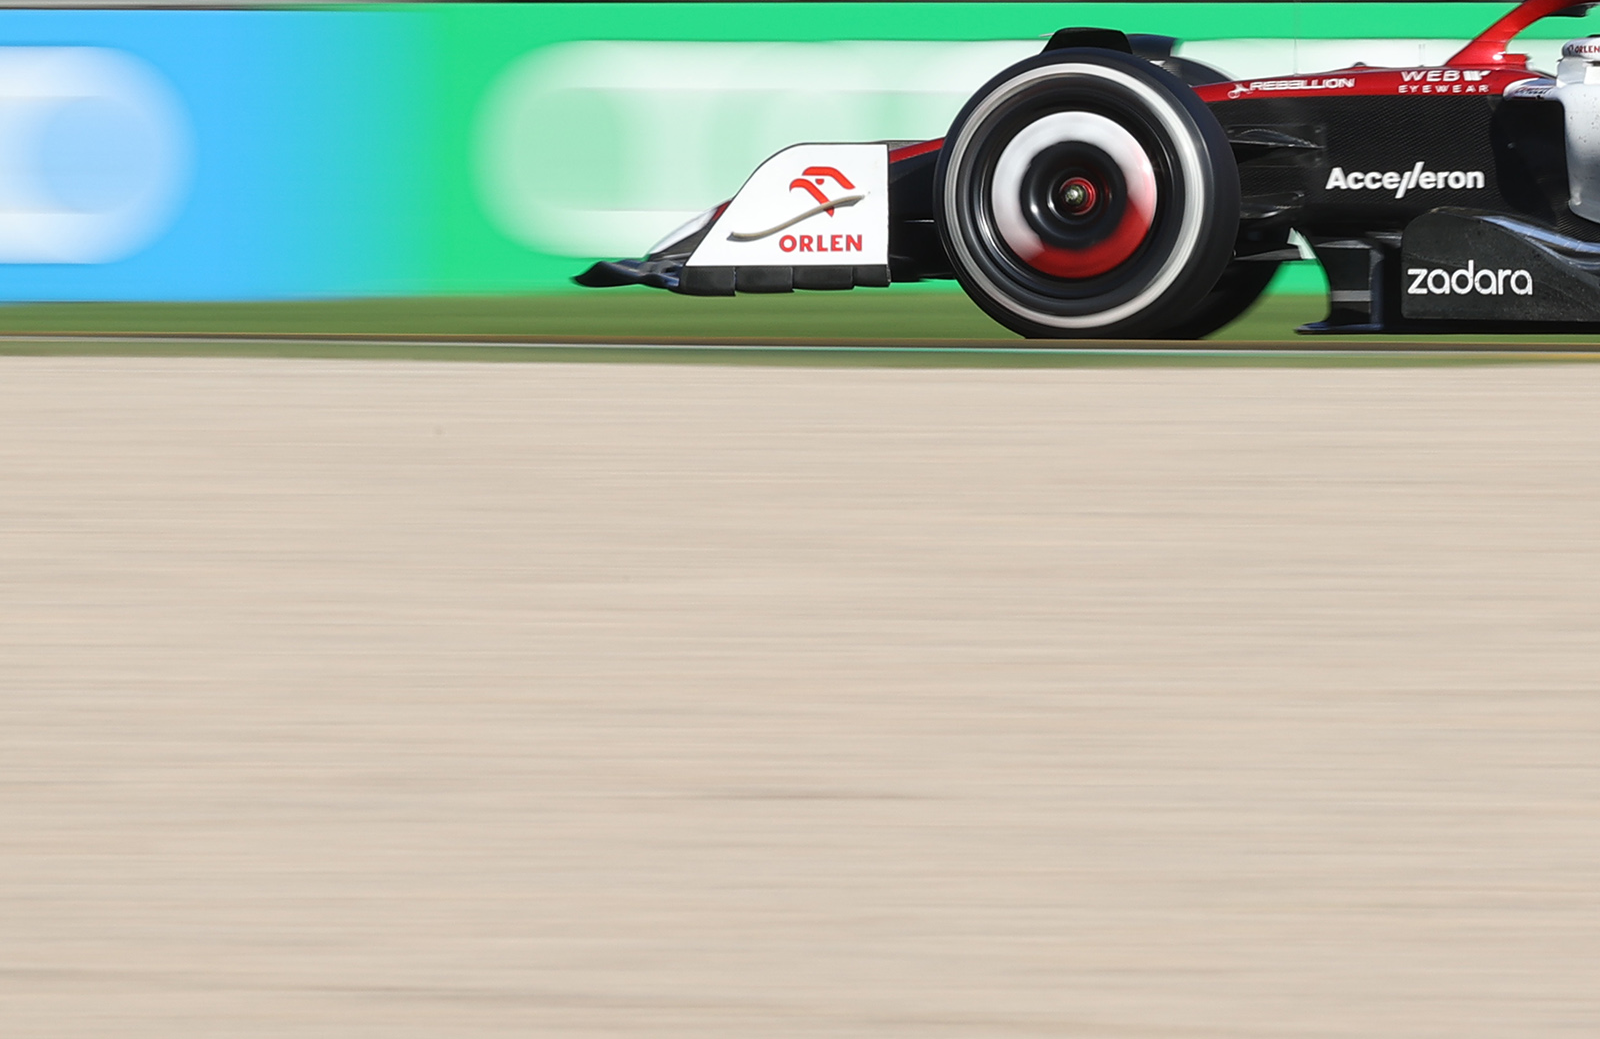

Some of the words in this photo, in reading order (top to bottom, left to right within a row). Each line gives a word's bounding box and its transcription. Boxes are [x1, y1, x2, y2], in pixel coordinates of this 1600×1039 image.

[1574, 45, 1600, 54] ORLEN
[1401, 70, 1460, 82] WEB
[1249, 77, 1356, 92] REBELLION
[1398, 84, 1490, 94] EYEWEAR
[778, 234, 863, 253] ORLEN
[1407, 260, 1533, 296] zadara
